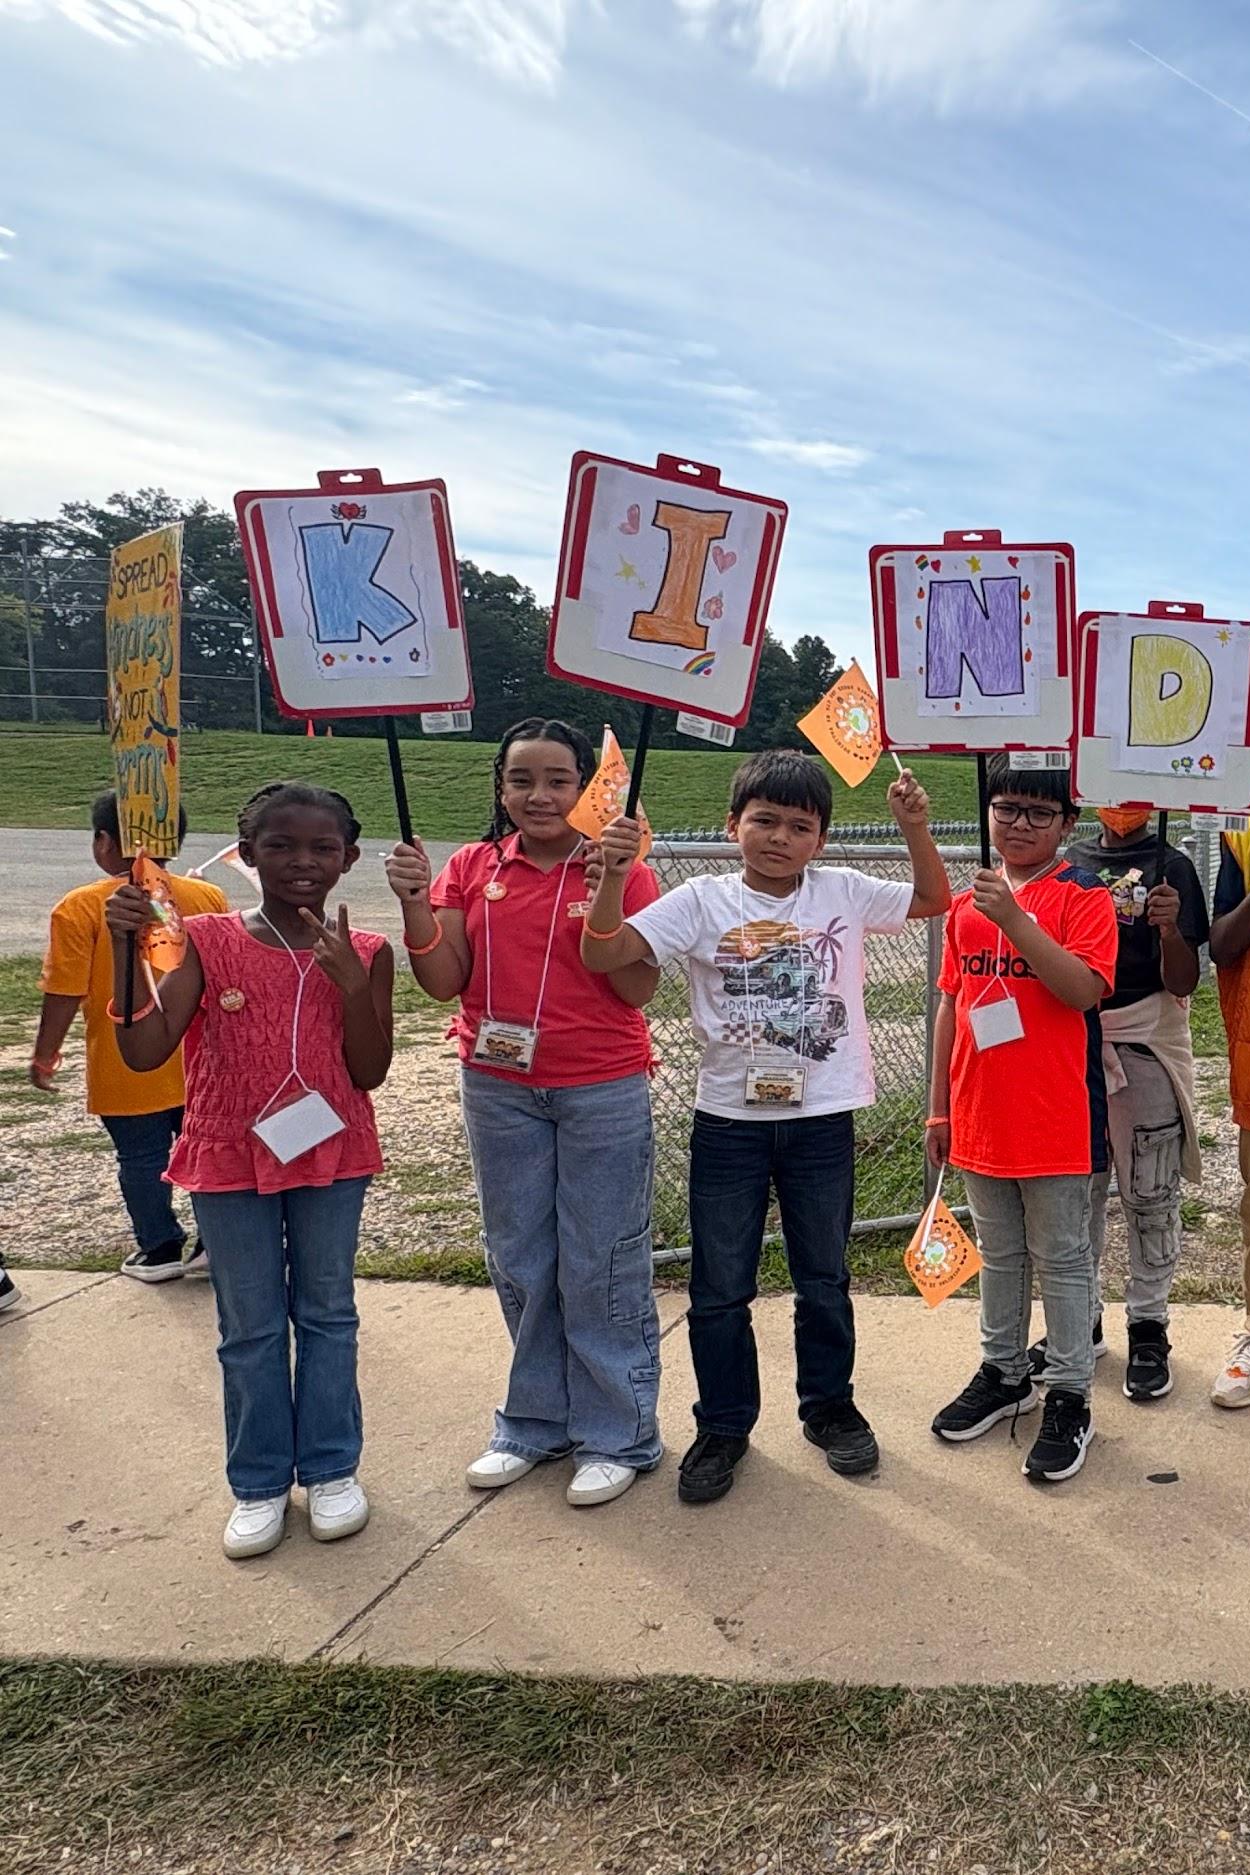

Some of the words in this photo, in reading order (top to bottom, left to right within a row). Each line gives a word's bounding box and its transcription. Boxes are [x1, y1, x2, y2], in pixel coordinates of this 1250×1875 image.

[116, 552, 168, 600] SPREAD
[300, 523, 417, 644] K
[628, 500, 732, 650] I
[925, 576, 1025, 699] N
[123, 688, 148, 720] NOT
[1127, 634, 1214, 747] D
[115, 743, 168, 823] erms
[720, 998, 790, 1011] ADVENTURE
